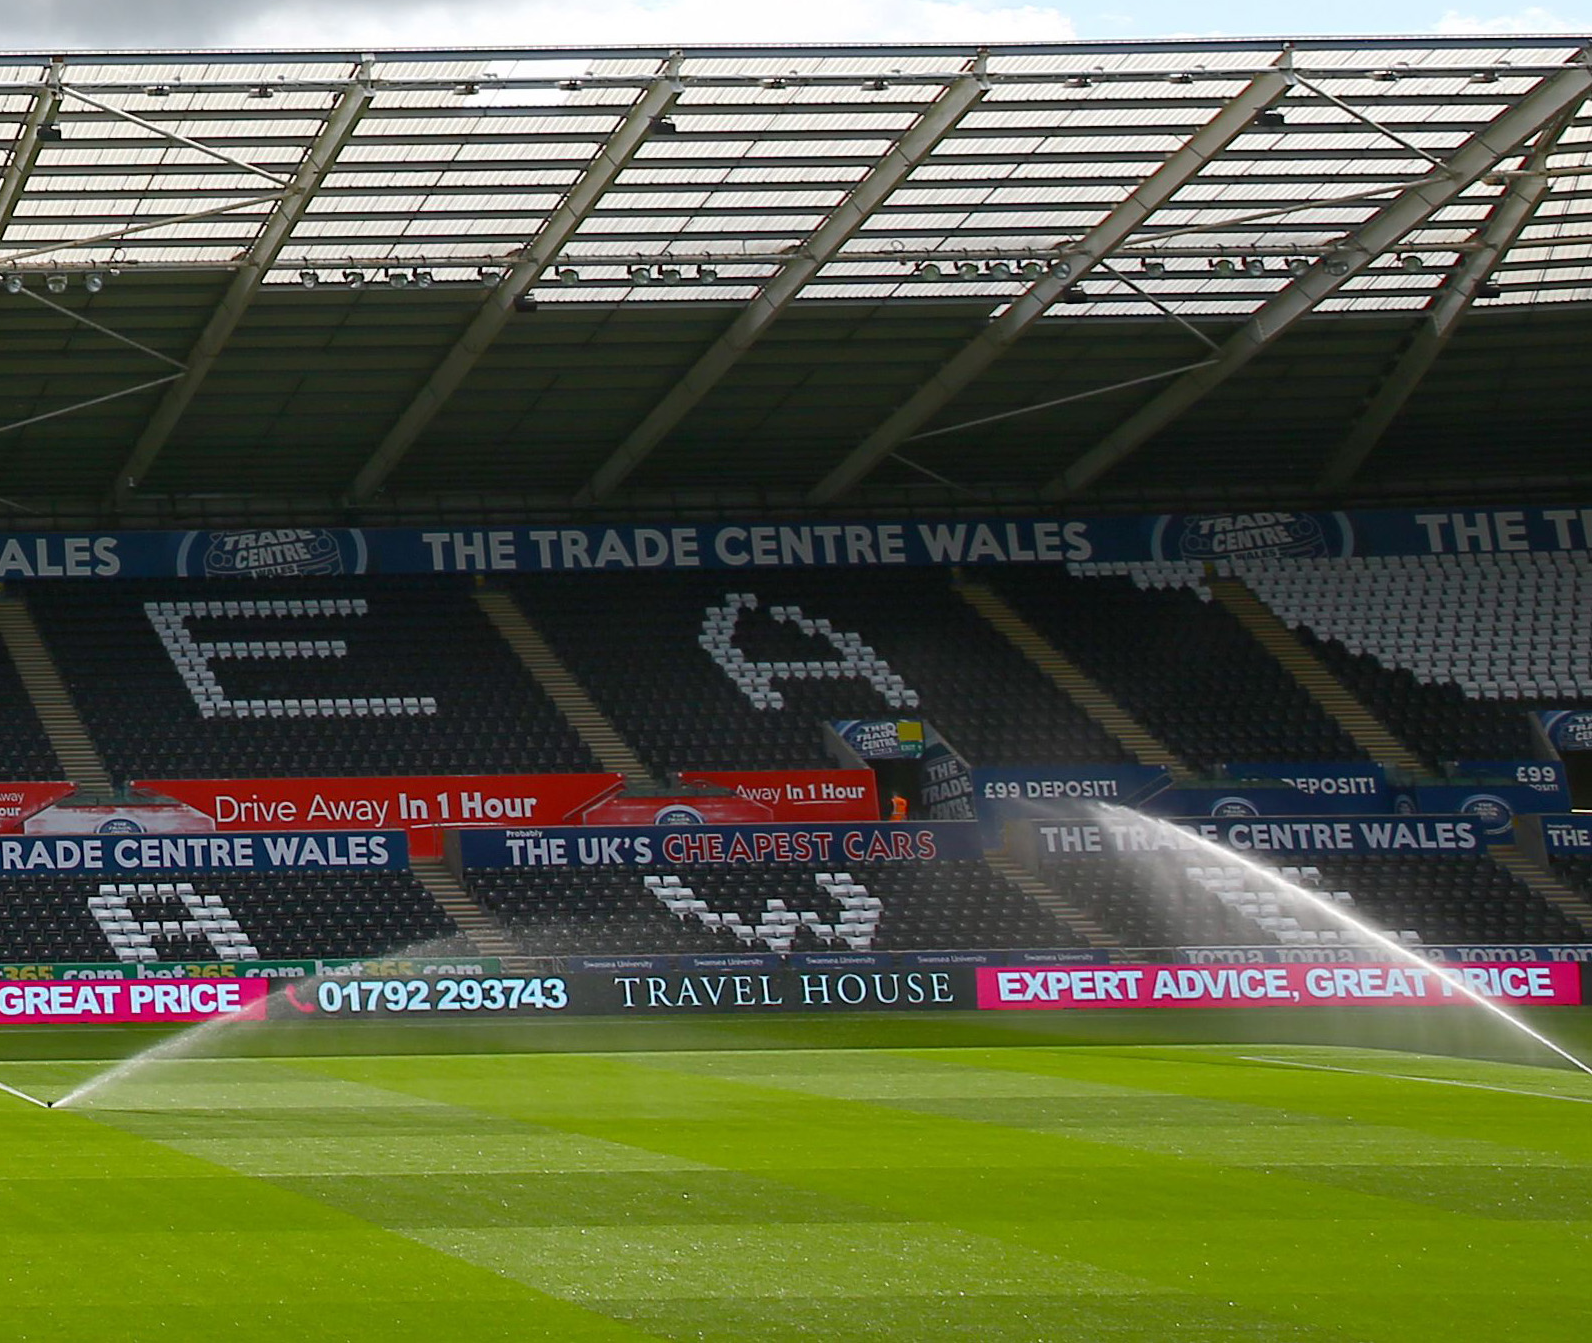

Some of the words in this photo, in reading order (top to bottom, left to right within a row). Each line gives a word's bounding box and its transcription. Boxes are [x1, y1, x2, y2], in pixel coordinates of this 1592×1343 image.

[1198, 512, 1297, 535] TRADE
[1210, 523, 1295, 553] CENTRE
[1415, 509, 1531, 554] THE
[221, 528, 317, 552] TRADE
[421, 531, 516, 571] THE
[529, 527, 701, 569] TRADE
[715, 524, 907, 567] CENTRE
[917, 521, 1093, 564] WALES
[234, 541, 312, 571] CENTRE
[250, 564, 298, 579] WALES
[927, 759, 958, 782] THE
[1516, 766, 1556, 783] £99
[736, 783, 781, 805] Away
[786, 783, 804, 800] In
[807, 784, 816, 799] 1
[821, 783, 866, 800] Hour
[920, 775, 974, 807] TRADE
[983, 782, 1021, 799] £99
[1026, 780, 1119, 798] DEPOSIT!
[215, 794, 298, 823] Drive
[307, 793, 390, 828] Away
[399, 792, 430, 820] In
[437, 792, 450, 818] 1
[461, 790, 538, 819] Hour
[505, 829, 544, 839] Probably
[505, 837, 568, 867] THE
[578, 836, 654, 866] UK'S
[662, 830, 833, 864] CHEAPEST
[843, 829, 937, 862] CARS
[1039, 826, 1103, 854] THE
[1228, 823, 1355, 850] CENTRE
[1359, 822, 1478, 850] WALES
[1547, 828, 1591, 848] THE
[113, 837, 254, 870] CENTRE
[263, 835, 390, 867] WALES
[583, 960, 615, 969] Swansea
[616, 960, 653, 970] University
[693, 958, 726, 967] Swansea
[726, 957, 764, 968] University
[805, 956, 838, 966] Swansea
[839, 955, 876, 966] University
[129, 983, 242, 1015] PRICE
[317, 981, 432, 1013] 01792
[435, 977, 569, 1012] 293743
[614, 974, 784, 1008] TRAVEL
[801, 972, 955, 1007] HOUSE
[995, 970, 1143, 1002] EXPERT
[1152, 968, 1301, 1003] ADVICE,
[1304, 967, 1431, 998] GREAT
[1440, 967, 1556, 998] PRICE
